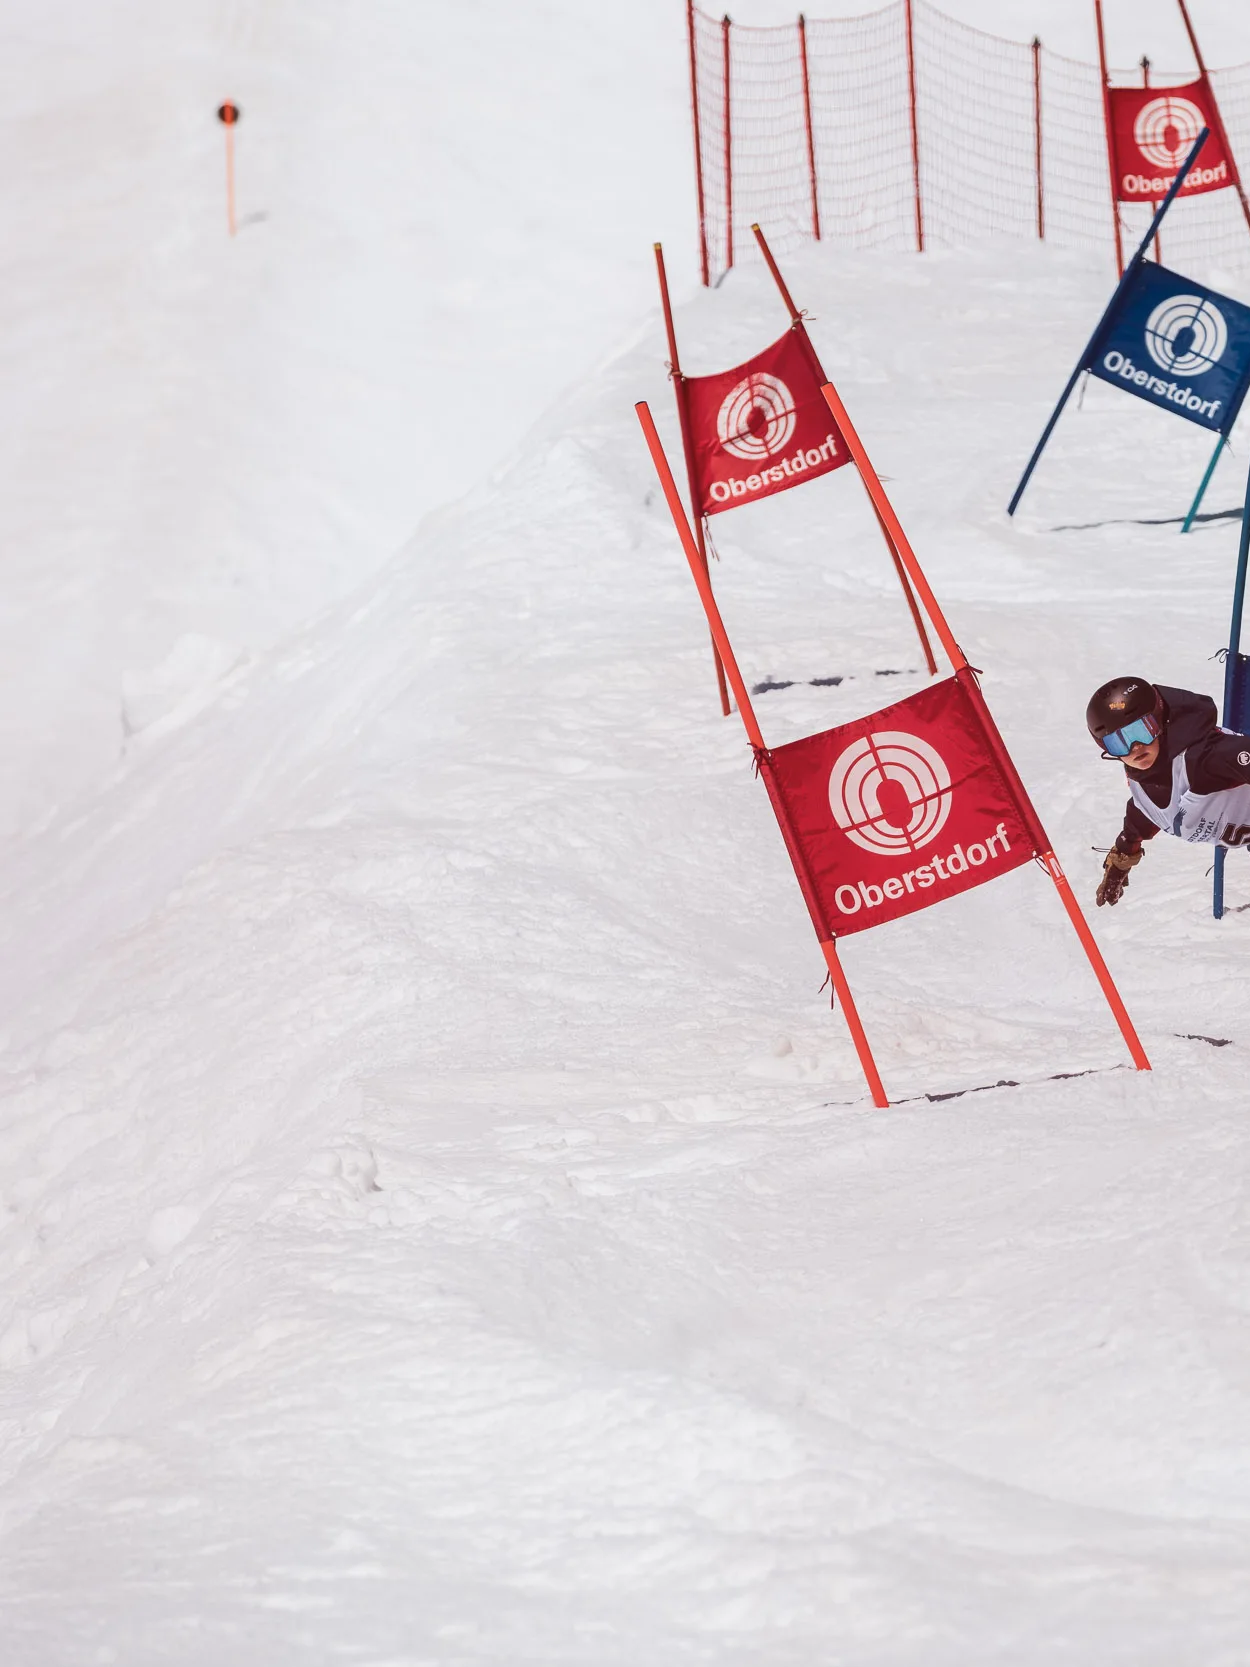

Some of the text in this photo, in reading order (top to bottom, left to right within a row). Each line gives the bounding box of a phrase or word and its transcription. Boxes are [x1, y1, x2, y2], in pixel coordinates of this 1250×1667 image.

[1122, 160, 1227, 194] Obertdorf
[1103, 350, 1222, 420] Oberstdorf
[709, 434, 839, 504] Oberstdorf
[834, 822, 1012, 916] Oberstdorf
